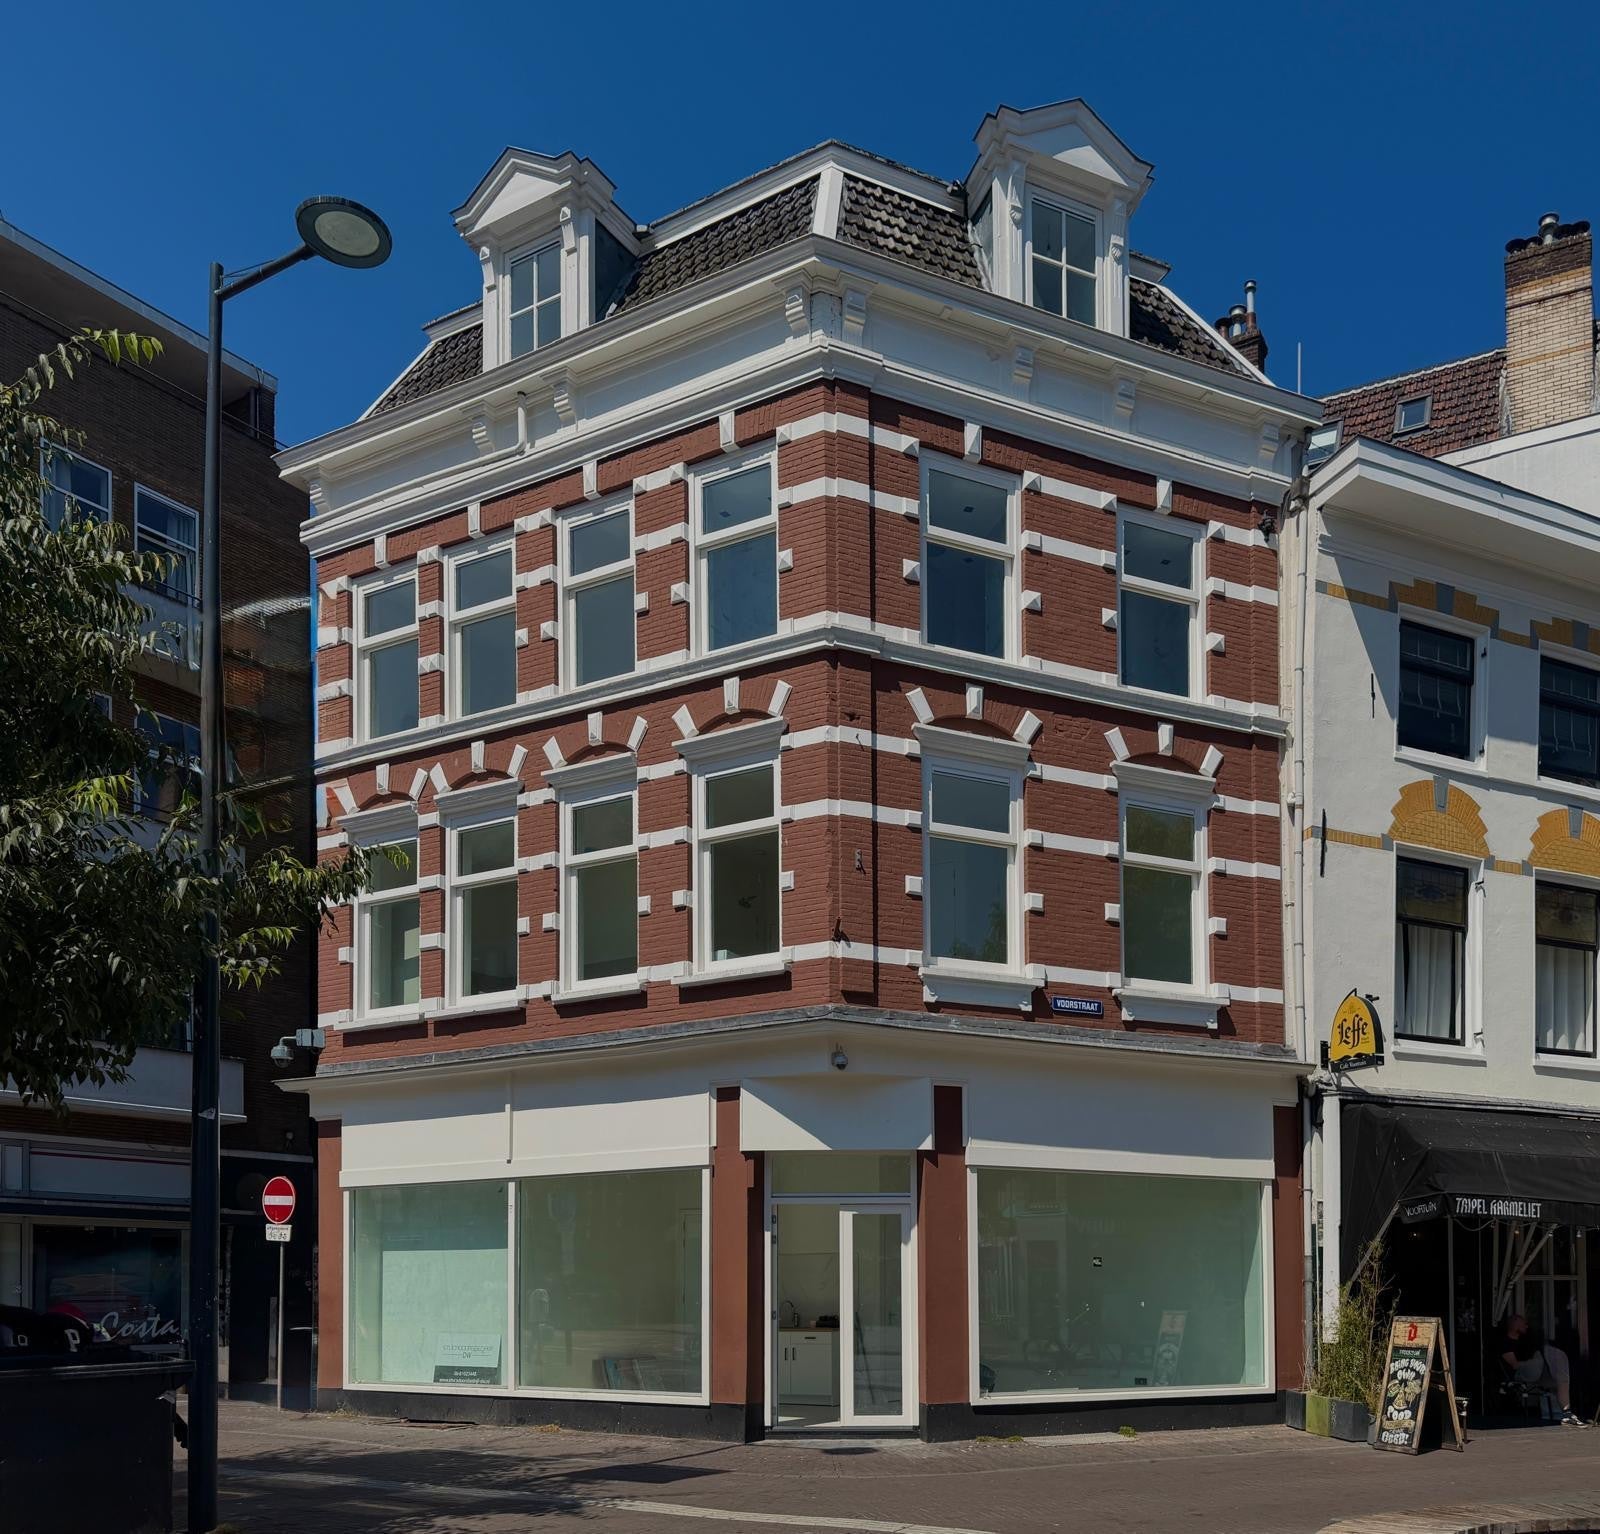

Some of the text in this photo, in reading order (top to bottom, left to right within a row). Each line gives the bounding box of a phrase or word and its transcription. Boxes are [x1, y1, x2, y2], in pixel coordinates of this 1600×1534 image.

[1056, 999, 1098, 1011] VOORSTRAAT
[1337, 1014, 1368, 1050] Leffe
[1455, 1197, 1542, 1218] TRIPEL KARMELIET
[100, 1311, 180, 1341] Costa
